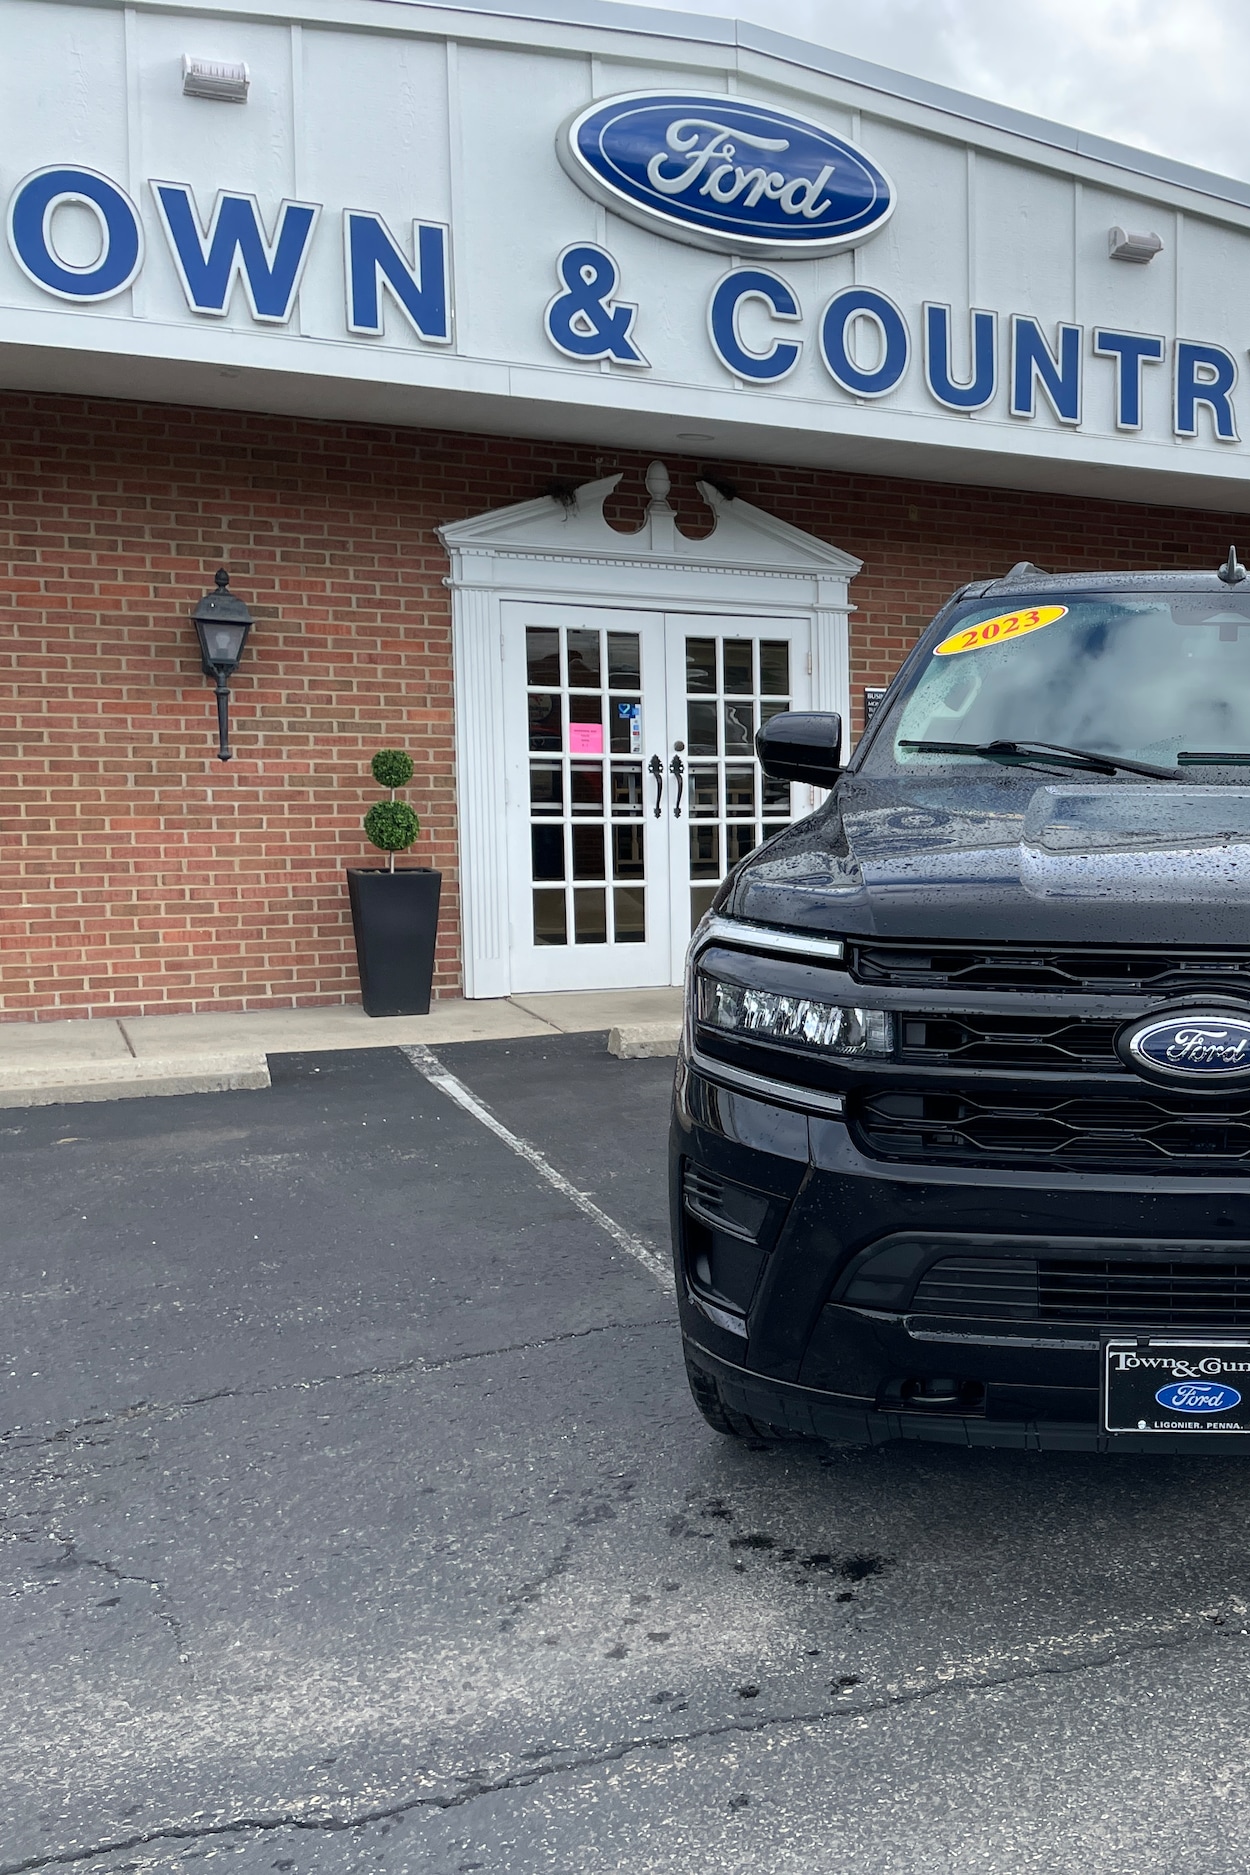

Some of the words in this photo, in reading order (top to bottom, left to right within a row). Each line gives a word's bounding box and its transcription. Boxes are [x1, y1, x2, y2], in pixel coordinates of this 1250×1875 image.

[647, 118, 836, 220] Ford
[7, 164, 454, 345] OWN
[544, 241, 652, 368] &
[961, 610, 1041, 649] 2023
[1165, 1028, 1248, 1063] Ford
[1109, 1351, 1176, 1371] Town
[1171, 1359, 1201, 1378] &
[1171, 1384, 1225, 1408] Ford
[1206, 1421, 1244, 1431] PENNA.
